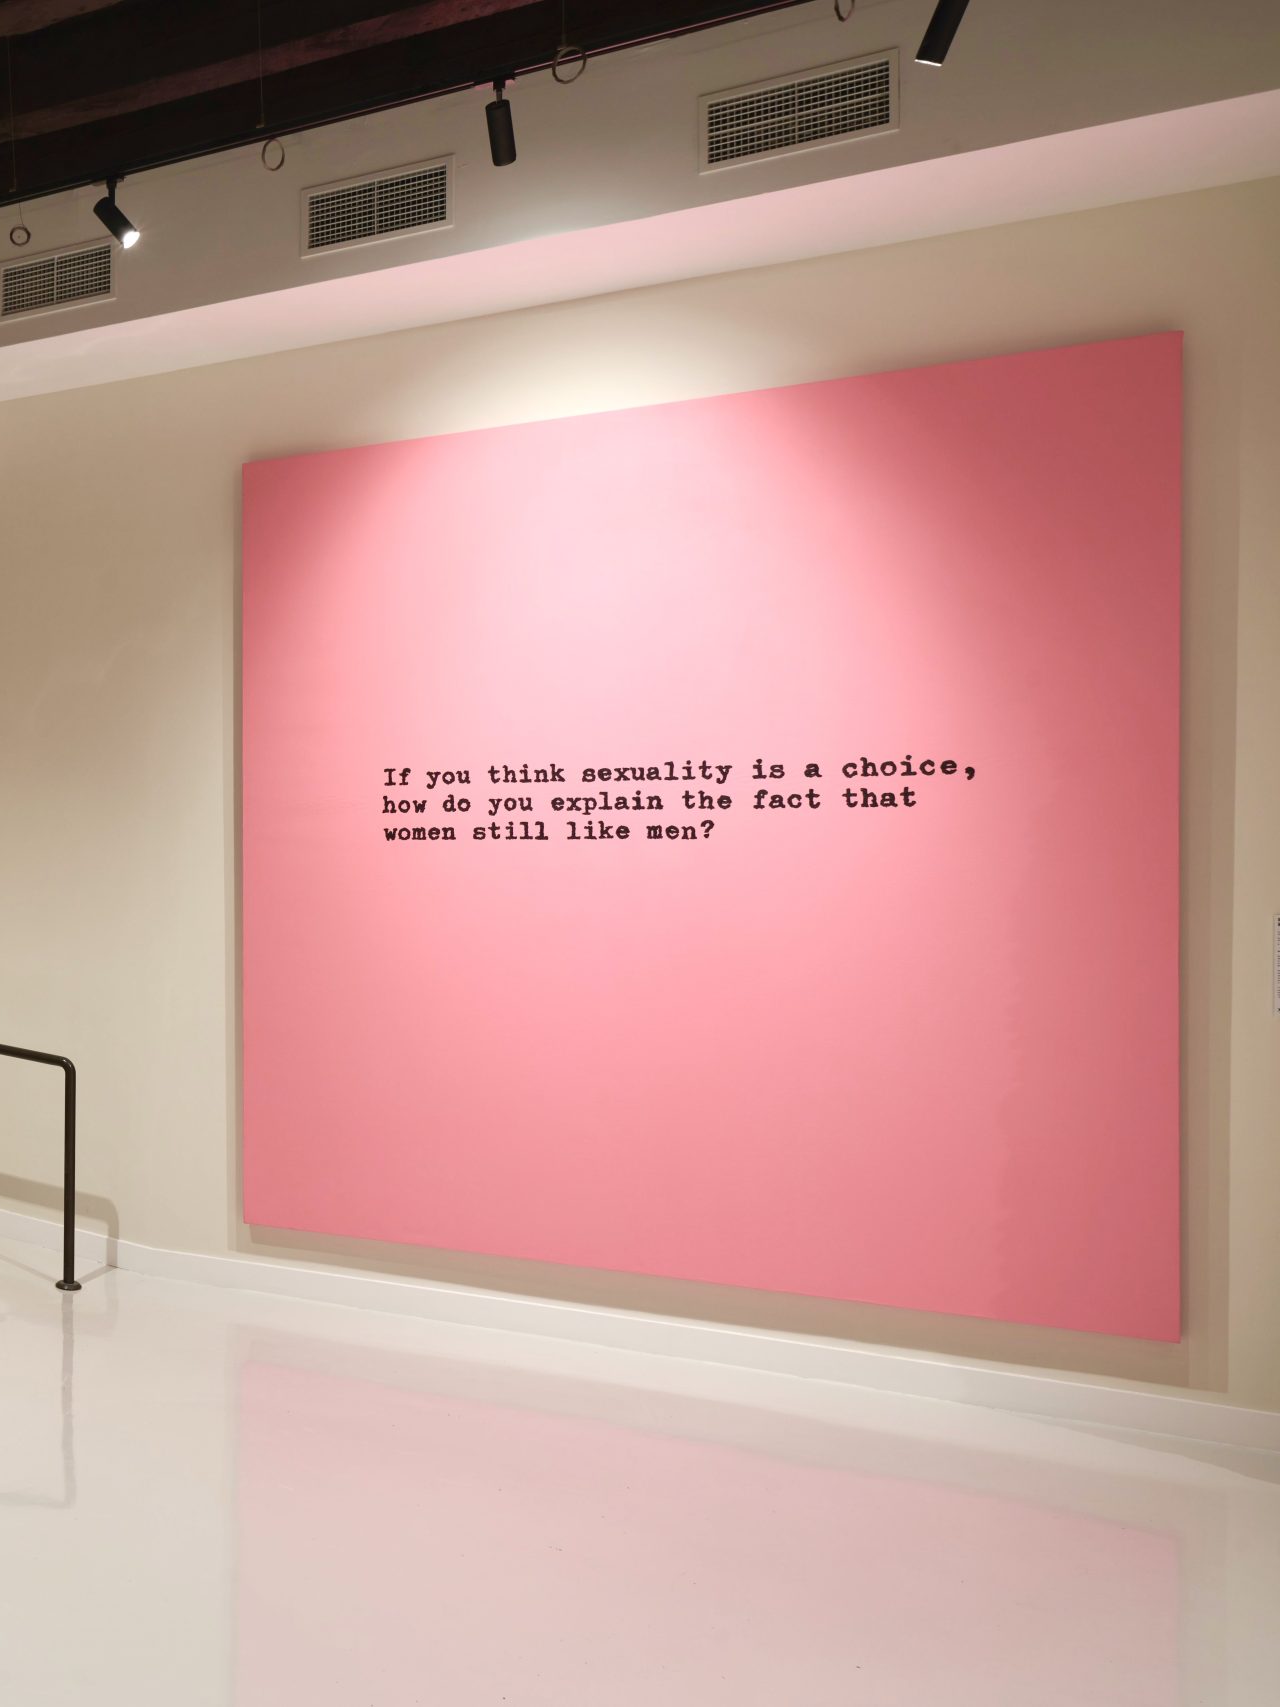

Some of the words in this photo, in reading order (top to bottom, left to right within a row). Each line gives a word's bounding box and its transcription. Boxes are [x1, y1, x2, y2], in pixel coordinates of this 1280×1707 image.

[383, 767, 412, 787] If
[426, 770, 471, 790] you
[487, 763, 566, 784] think
[581, 760, 733, 785] sexuality
[752, 758, 785, 780] is
[803, 763, 823, 778] a
[841, 754, 976, 781] choice,
[382, 795, 427, 814] how
[442, 793, 471, 813] do
[488, 797, 533, 817] you
[550, 790, 664, 816] explain
[681, 790, 733, 810] the
[753, 788, 821, 810] fact
[841, 786, 917, 808] that
[383, 826, 457, 842] women
[472, 820, 549, 841] still
[566, 820, 631, 840] like
[646, 819, 715, 840] men?
